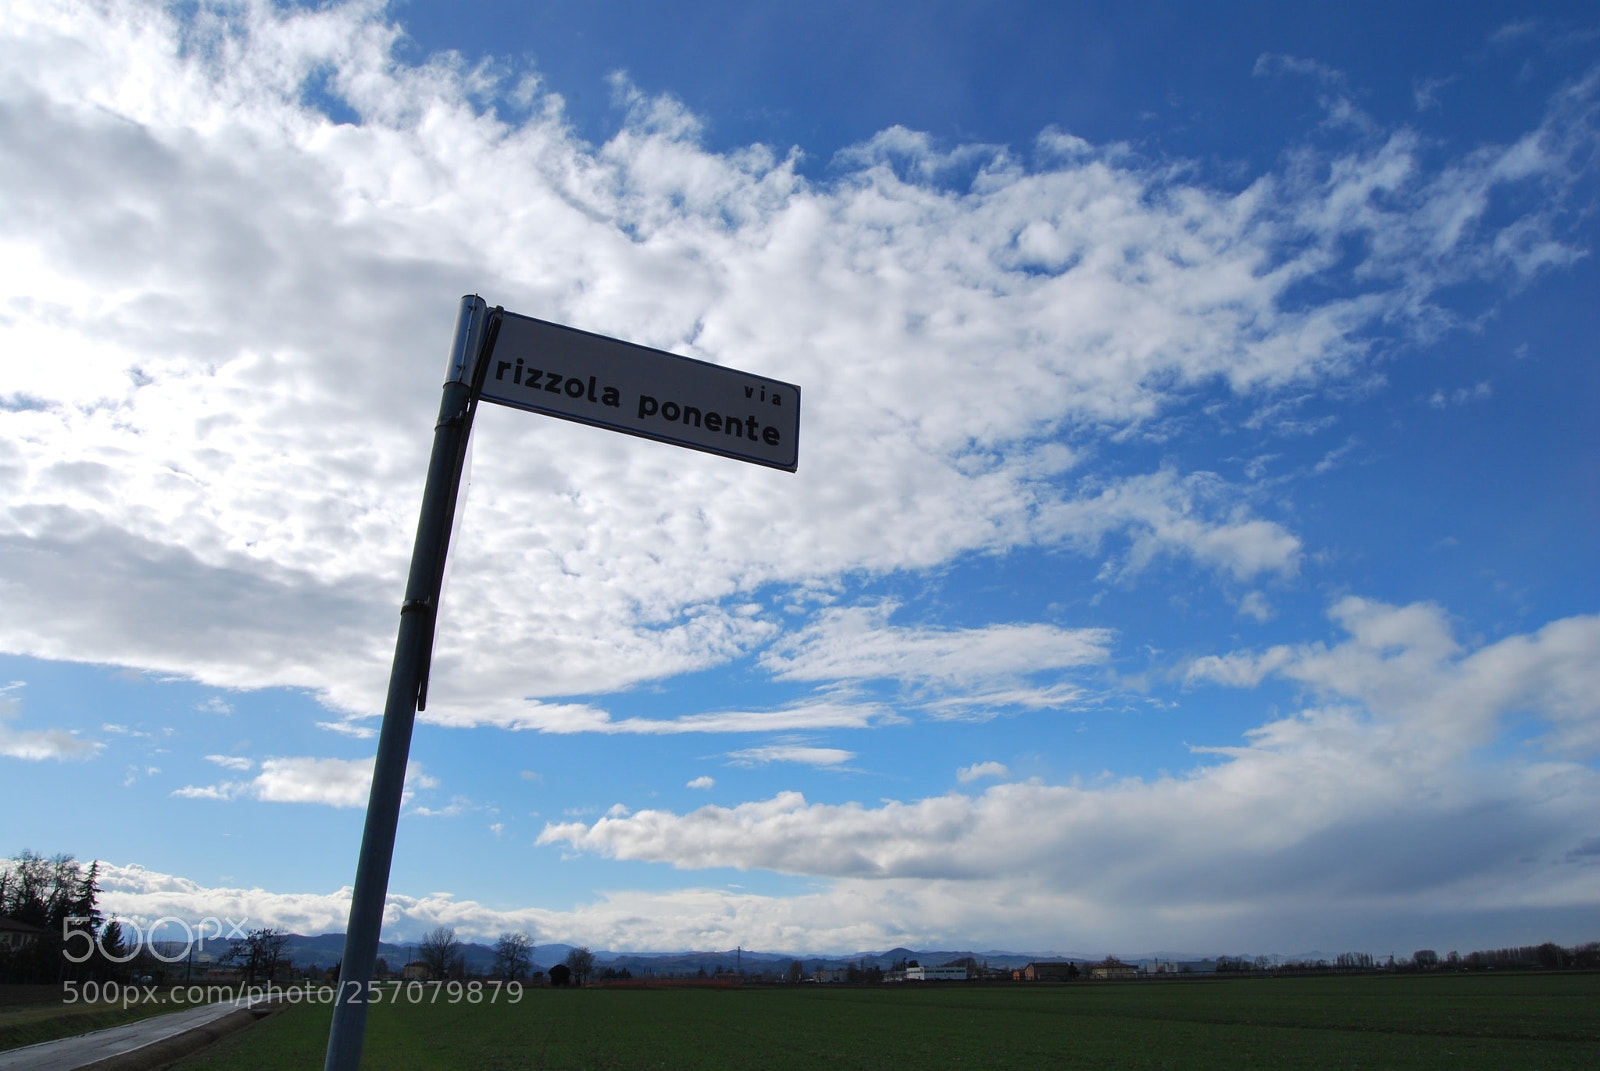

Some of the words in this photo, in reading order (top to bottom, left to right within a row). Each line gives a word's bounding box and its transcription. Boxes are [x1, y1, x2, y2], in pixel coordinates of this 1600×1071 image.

[496, 358, 621, 408] rizzola
[638, 394, 781, 446] ponente
[744, 385, 782, 406] via
